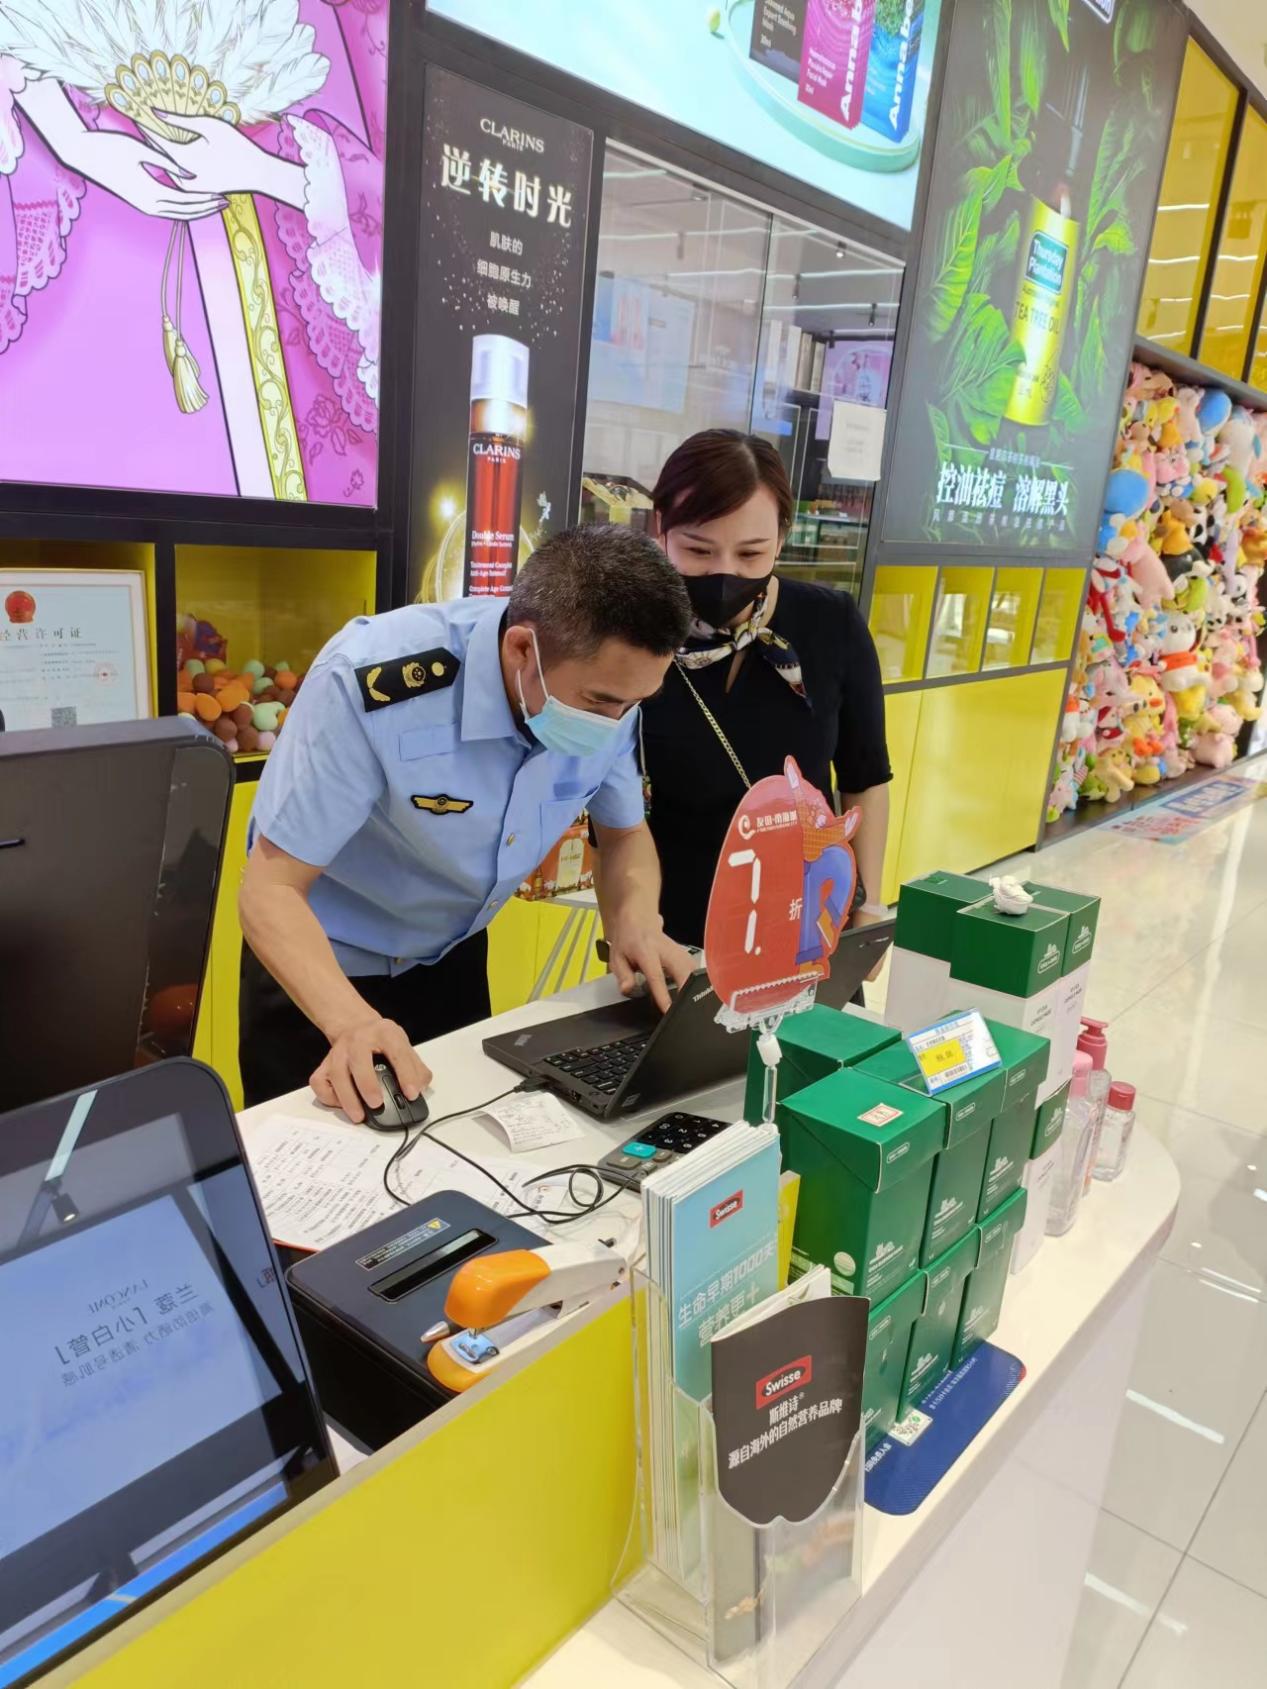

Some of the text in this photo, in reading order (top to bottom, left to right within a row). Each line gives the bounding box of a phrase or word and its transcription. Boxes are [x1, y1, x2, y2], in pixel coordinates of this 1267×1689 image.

[480, 118, 544, 153] CLARINS
[441, 143, 572, 228] 逆转时光
[489, 231, 523, 256] 肌肤的
[476, 258, 532, 288] 细胞原生力
[487, 292, 520, 315] 被唤醒
[473, 443, 521, 460] CLARINS
[936, 461, 1070, 516] 控油祛痘 溶解黑头
[471, 530, 515, 541] Double Serum
[789, 897, 803, 921] 折
[714, 1200, 738, 1220] Swisse
[765, 1370, 801, 1396] Swisse
[728, 1398, 843, 1469] 源自海外的自然营养品牌
